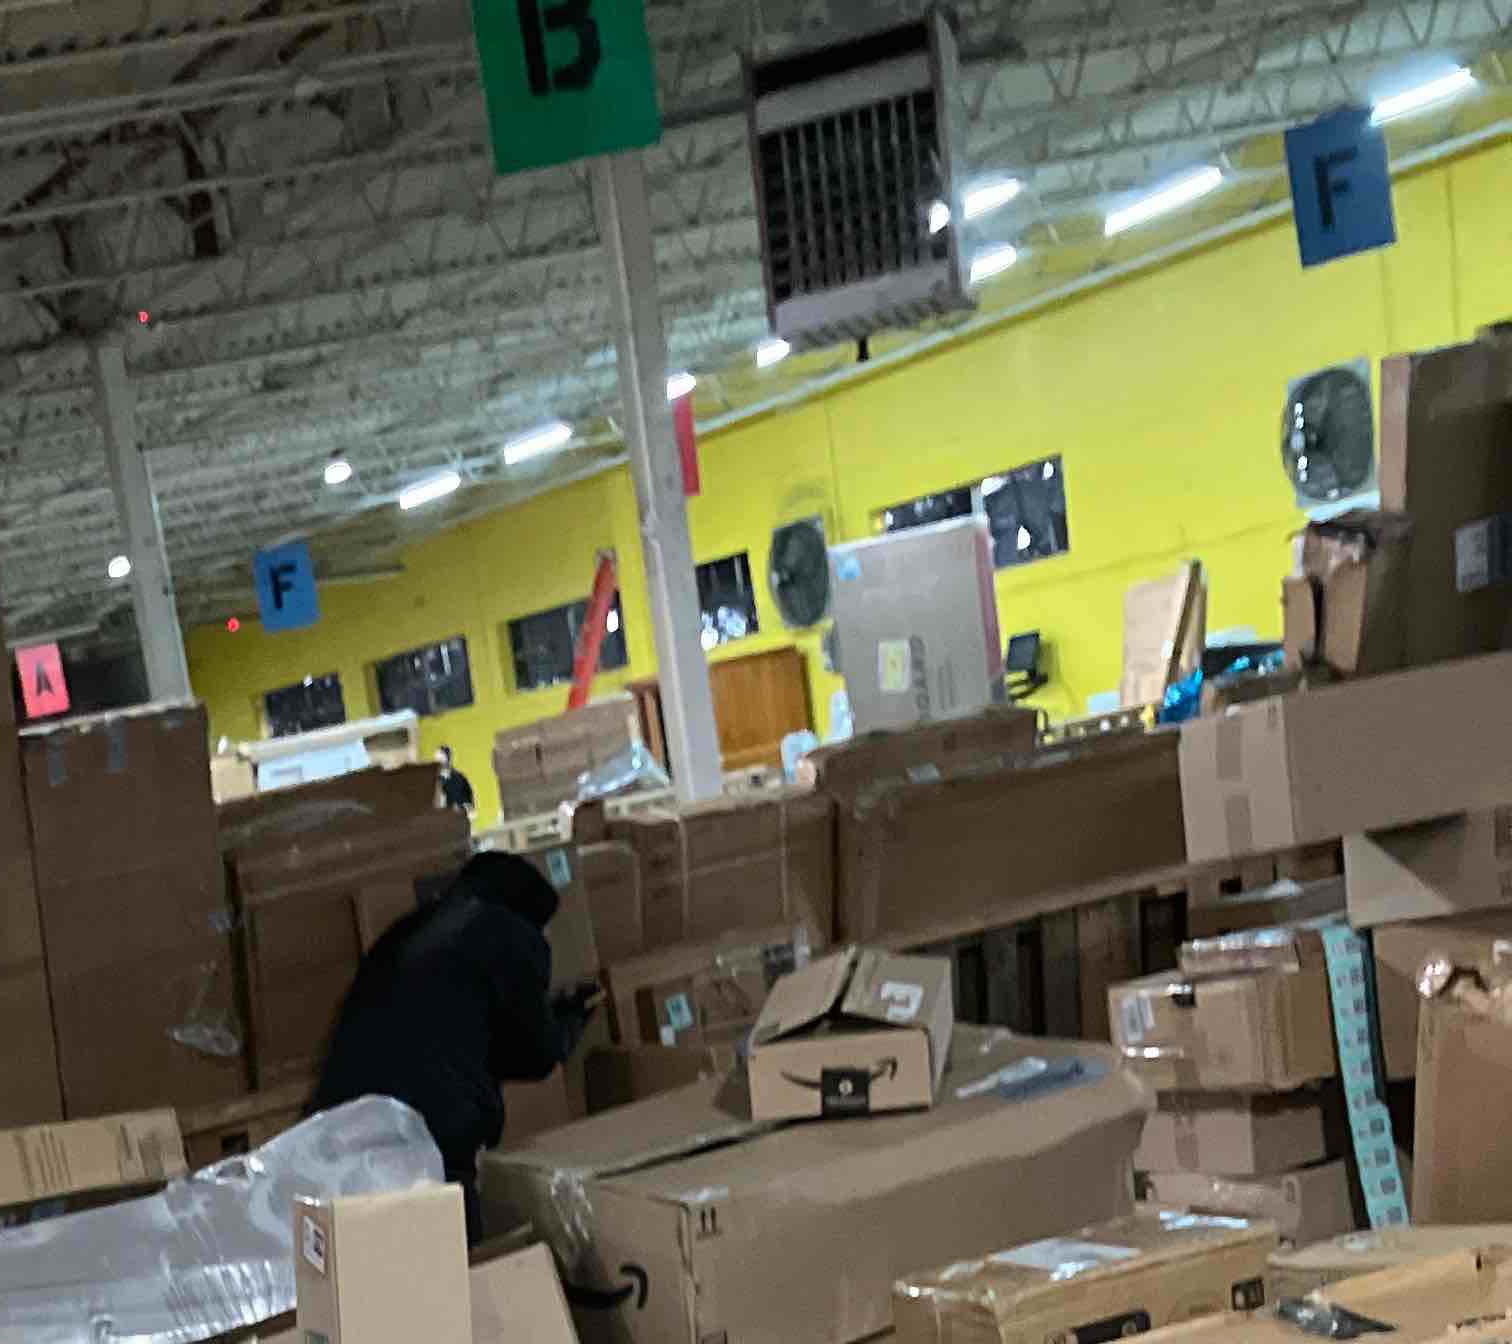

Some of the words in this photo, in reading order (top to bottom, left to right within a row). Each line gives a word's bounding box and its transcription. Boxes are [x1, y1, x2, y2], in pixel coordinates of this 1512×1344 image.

[1310, 144, 1360, 236] F
[267, 563, 297, 611] F
[33, 663, 55, 696] A
